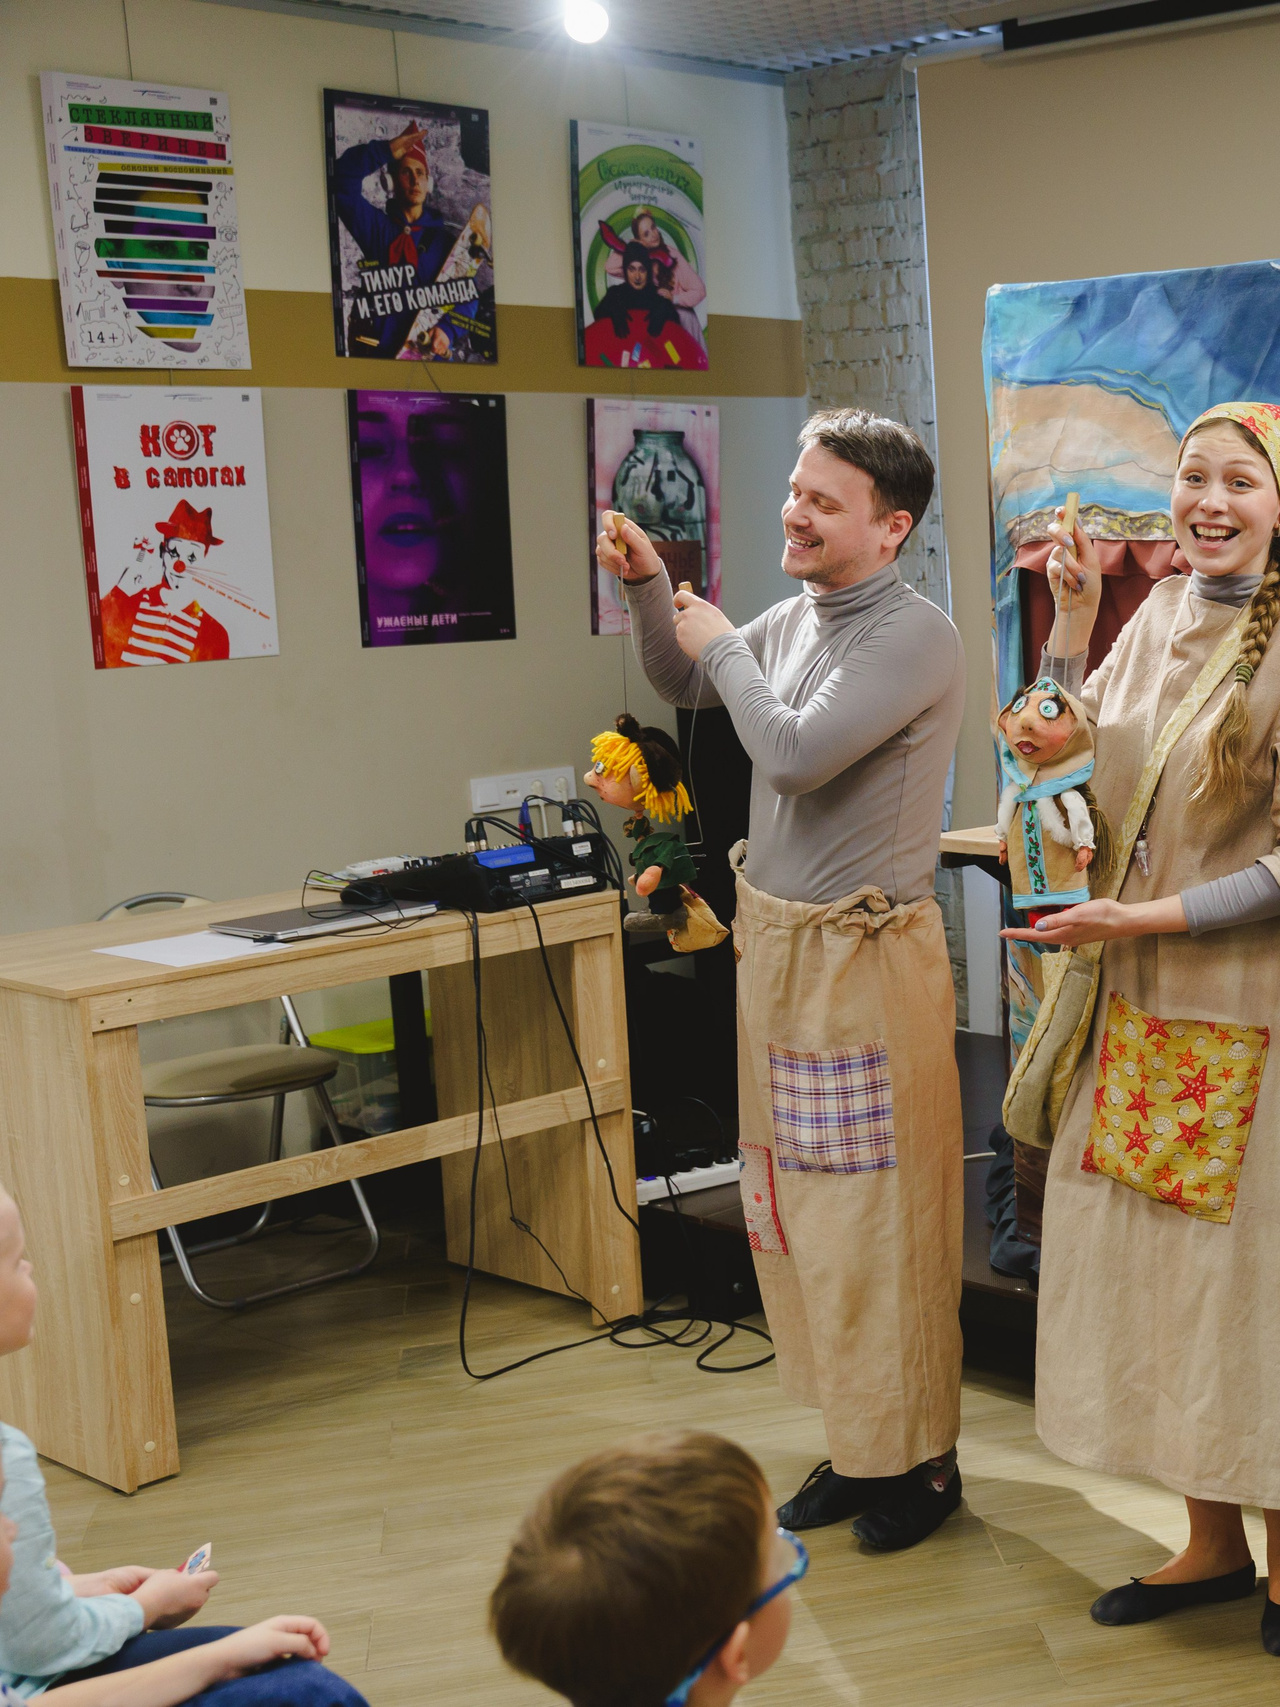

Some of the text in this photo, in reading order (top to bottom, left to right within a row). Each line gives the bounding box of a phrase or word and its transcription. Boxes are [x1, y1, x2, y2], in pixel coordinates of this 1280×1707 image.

[69, 107, 213, 129] СТЕКЛЯННЫЙ
[85, 127, 224, 158] ЗВЕРИНЕЦ
[361, 264, 415, 293] ТИМУР
[356, 279, 479, 319] И ЕГО КОМАНДА
[88, 331, 118, 343] 14+
[431, 613, 458, 627] ДЕТИ
